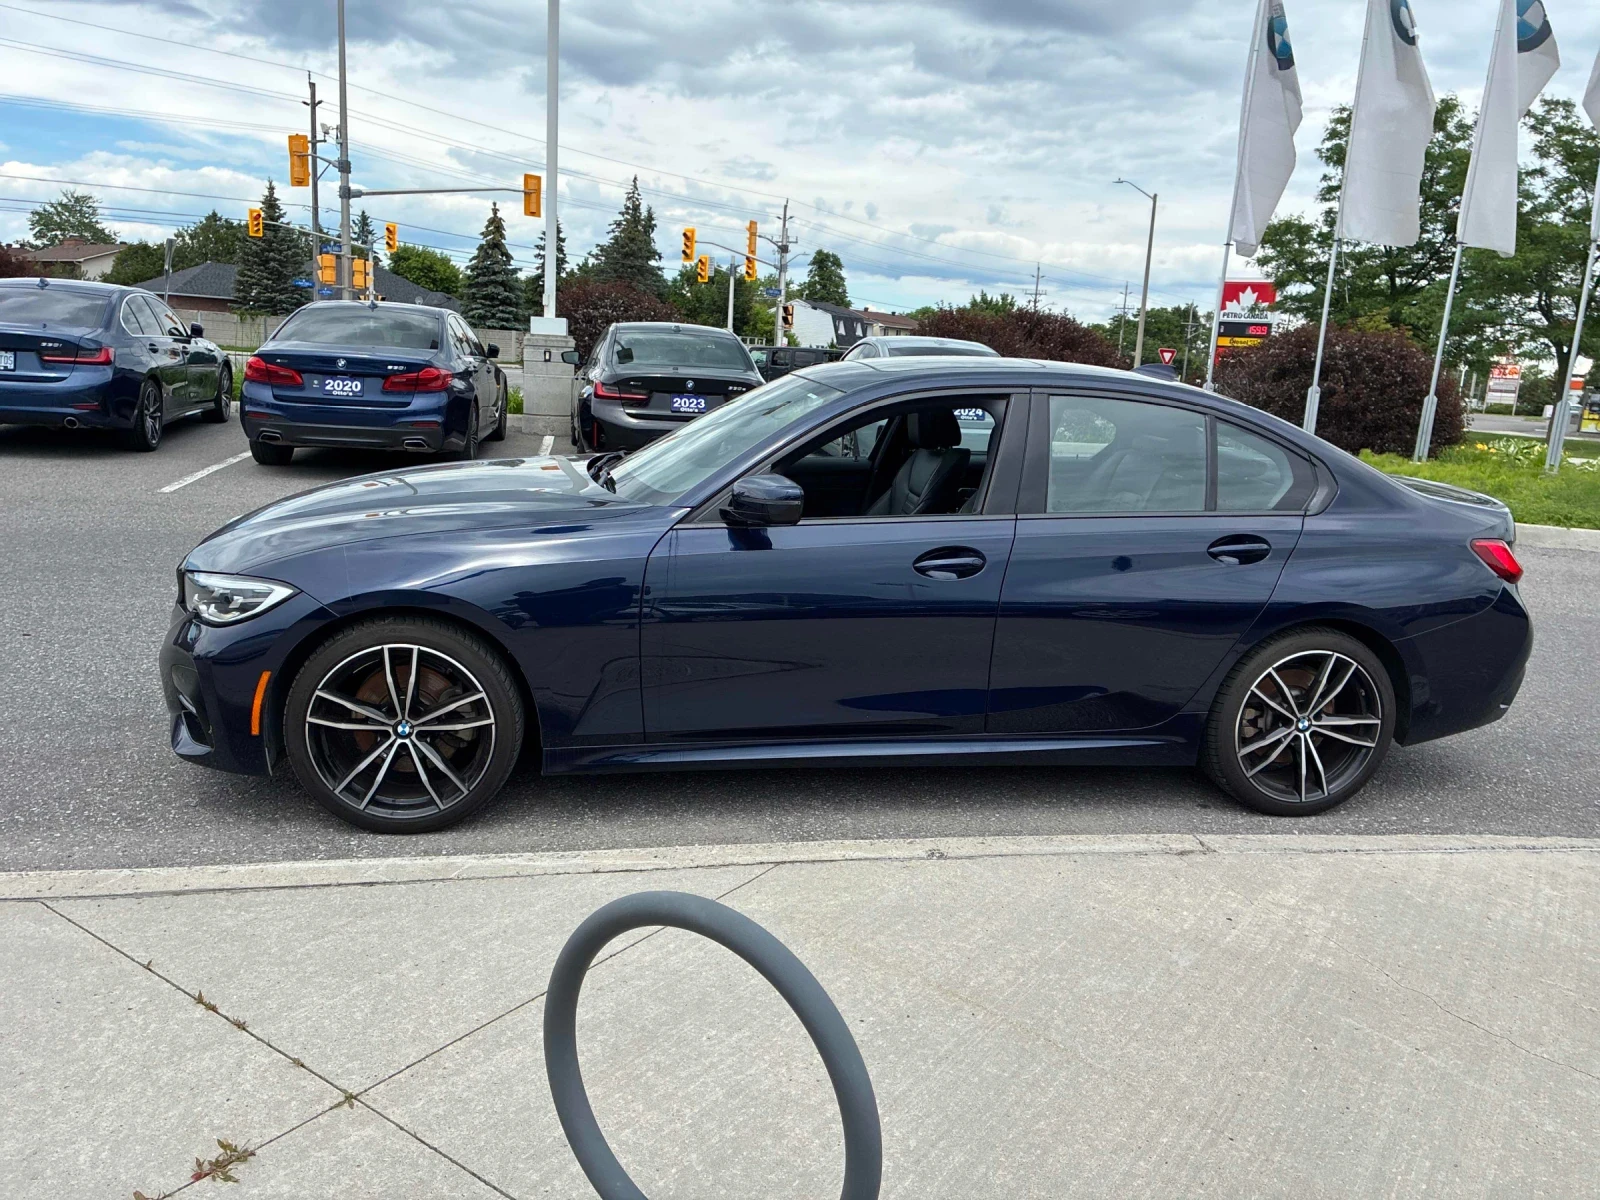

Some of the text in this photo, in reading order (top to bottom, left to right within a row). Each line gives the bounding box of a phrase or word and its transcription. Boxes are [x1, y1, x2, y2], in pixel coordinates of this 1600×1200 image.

[325, 379, 361, 392] 2020
[673, 398, 705, 408] 2023
[954, 408, 983, 416] 2024
